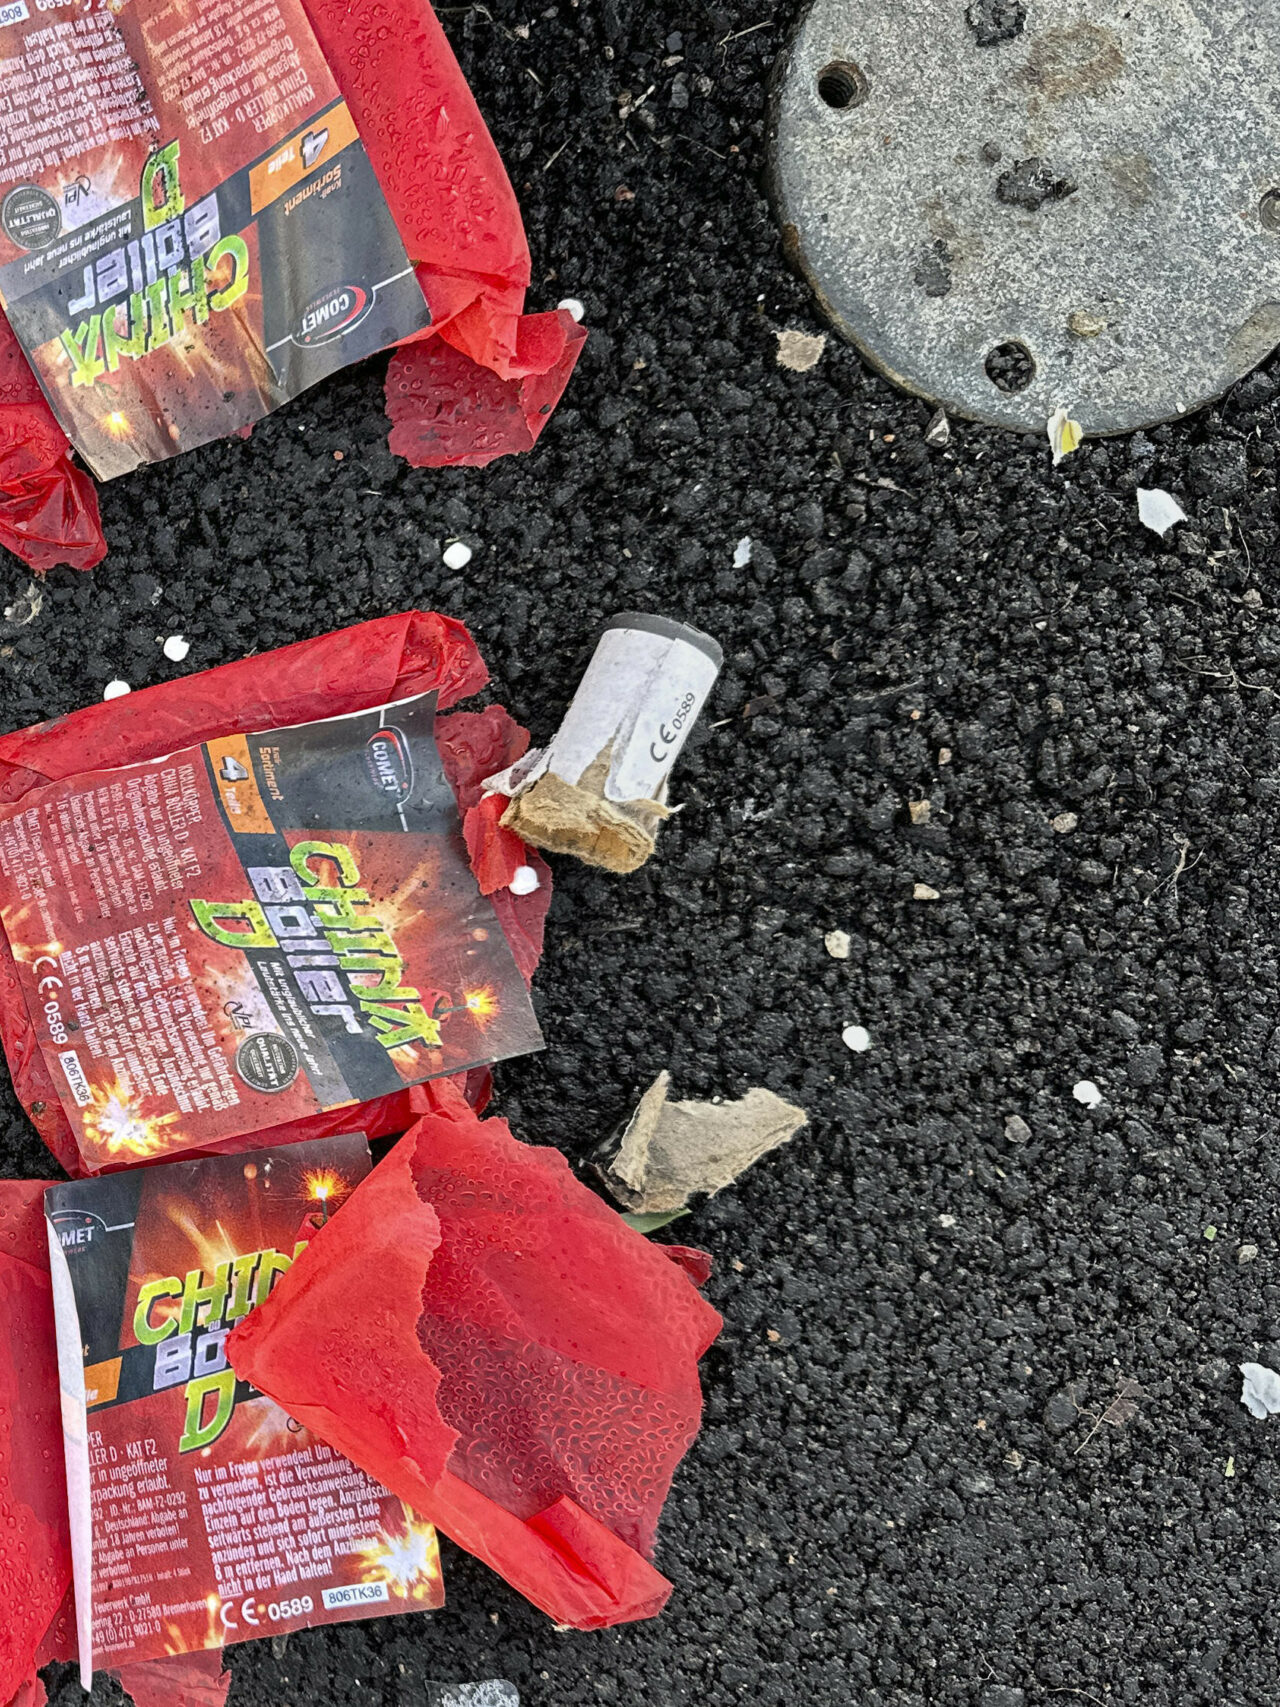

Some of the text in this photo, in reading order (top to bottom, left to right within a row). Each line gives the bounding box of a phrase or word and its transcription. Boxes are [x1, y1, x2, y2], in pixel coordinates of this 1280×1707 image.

[267, 128, 329, 175] 4 Teile
[141, 139, 185, 231] D
[285, 164, 342, 216] Sortiment
[60, 235, 249, 387] CHINA
[301, 293, 349, 336] COMET
[672, 692, 696, 730] 0589
[219, 756, 249, 781] 4
[257, 744, 284, 803] Sortiment
[371, 742, 401, 794] COMET
[189, 899, 280, 948] D
[289, 840, 444, 1048] CHINA
[42, 999, 68, 1046] 0589
[63, 1053, 90, 1104] 806TK36
[252, 1035, 282, 1089] QUALITÄT
[133, 1240, 309, 1345] CHIN
[179, 1369, 237, 1453] D
[126, 1438, 157, 1458] KAT F2
[193, 1446, 313, 1484] Nur im Freien verwenden!
[197, 1456, 352, 1500] zu vermeiden, ist die Verwendung
[200, 1468, 365, 1518] nachfolgender Gebrauchsanweisung
[204, 1497, 306, 1532] Einzeln auf den Boden
[207, 1498, 380, 1548] seitwärts stehend am äußersten Ende
[210, 1516, 381, 1564] anzünden und sich sofort mindestens
[213, 1542, 332, 1580] 8 m entfernen. Nach dem
[217, 1558, 332, 1597] nicht in der Hand halten!
[266, 1595, 315, 1622] 0589
[327, 1585, 383, 1604] 806TK36
